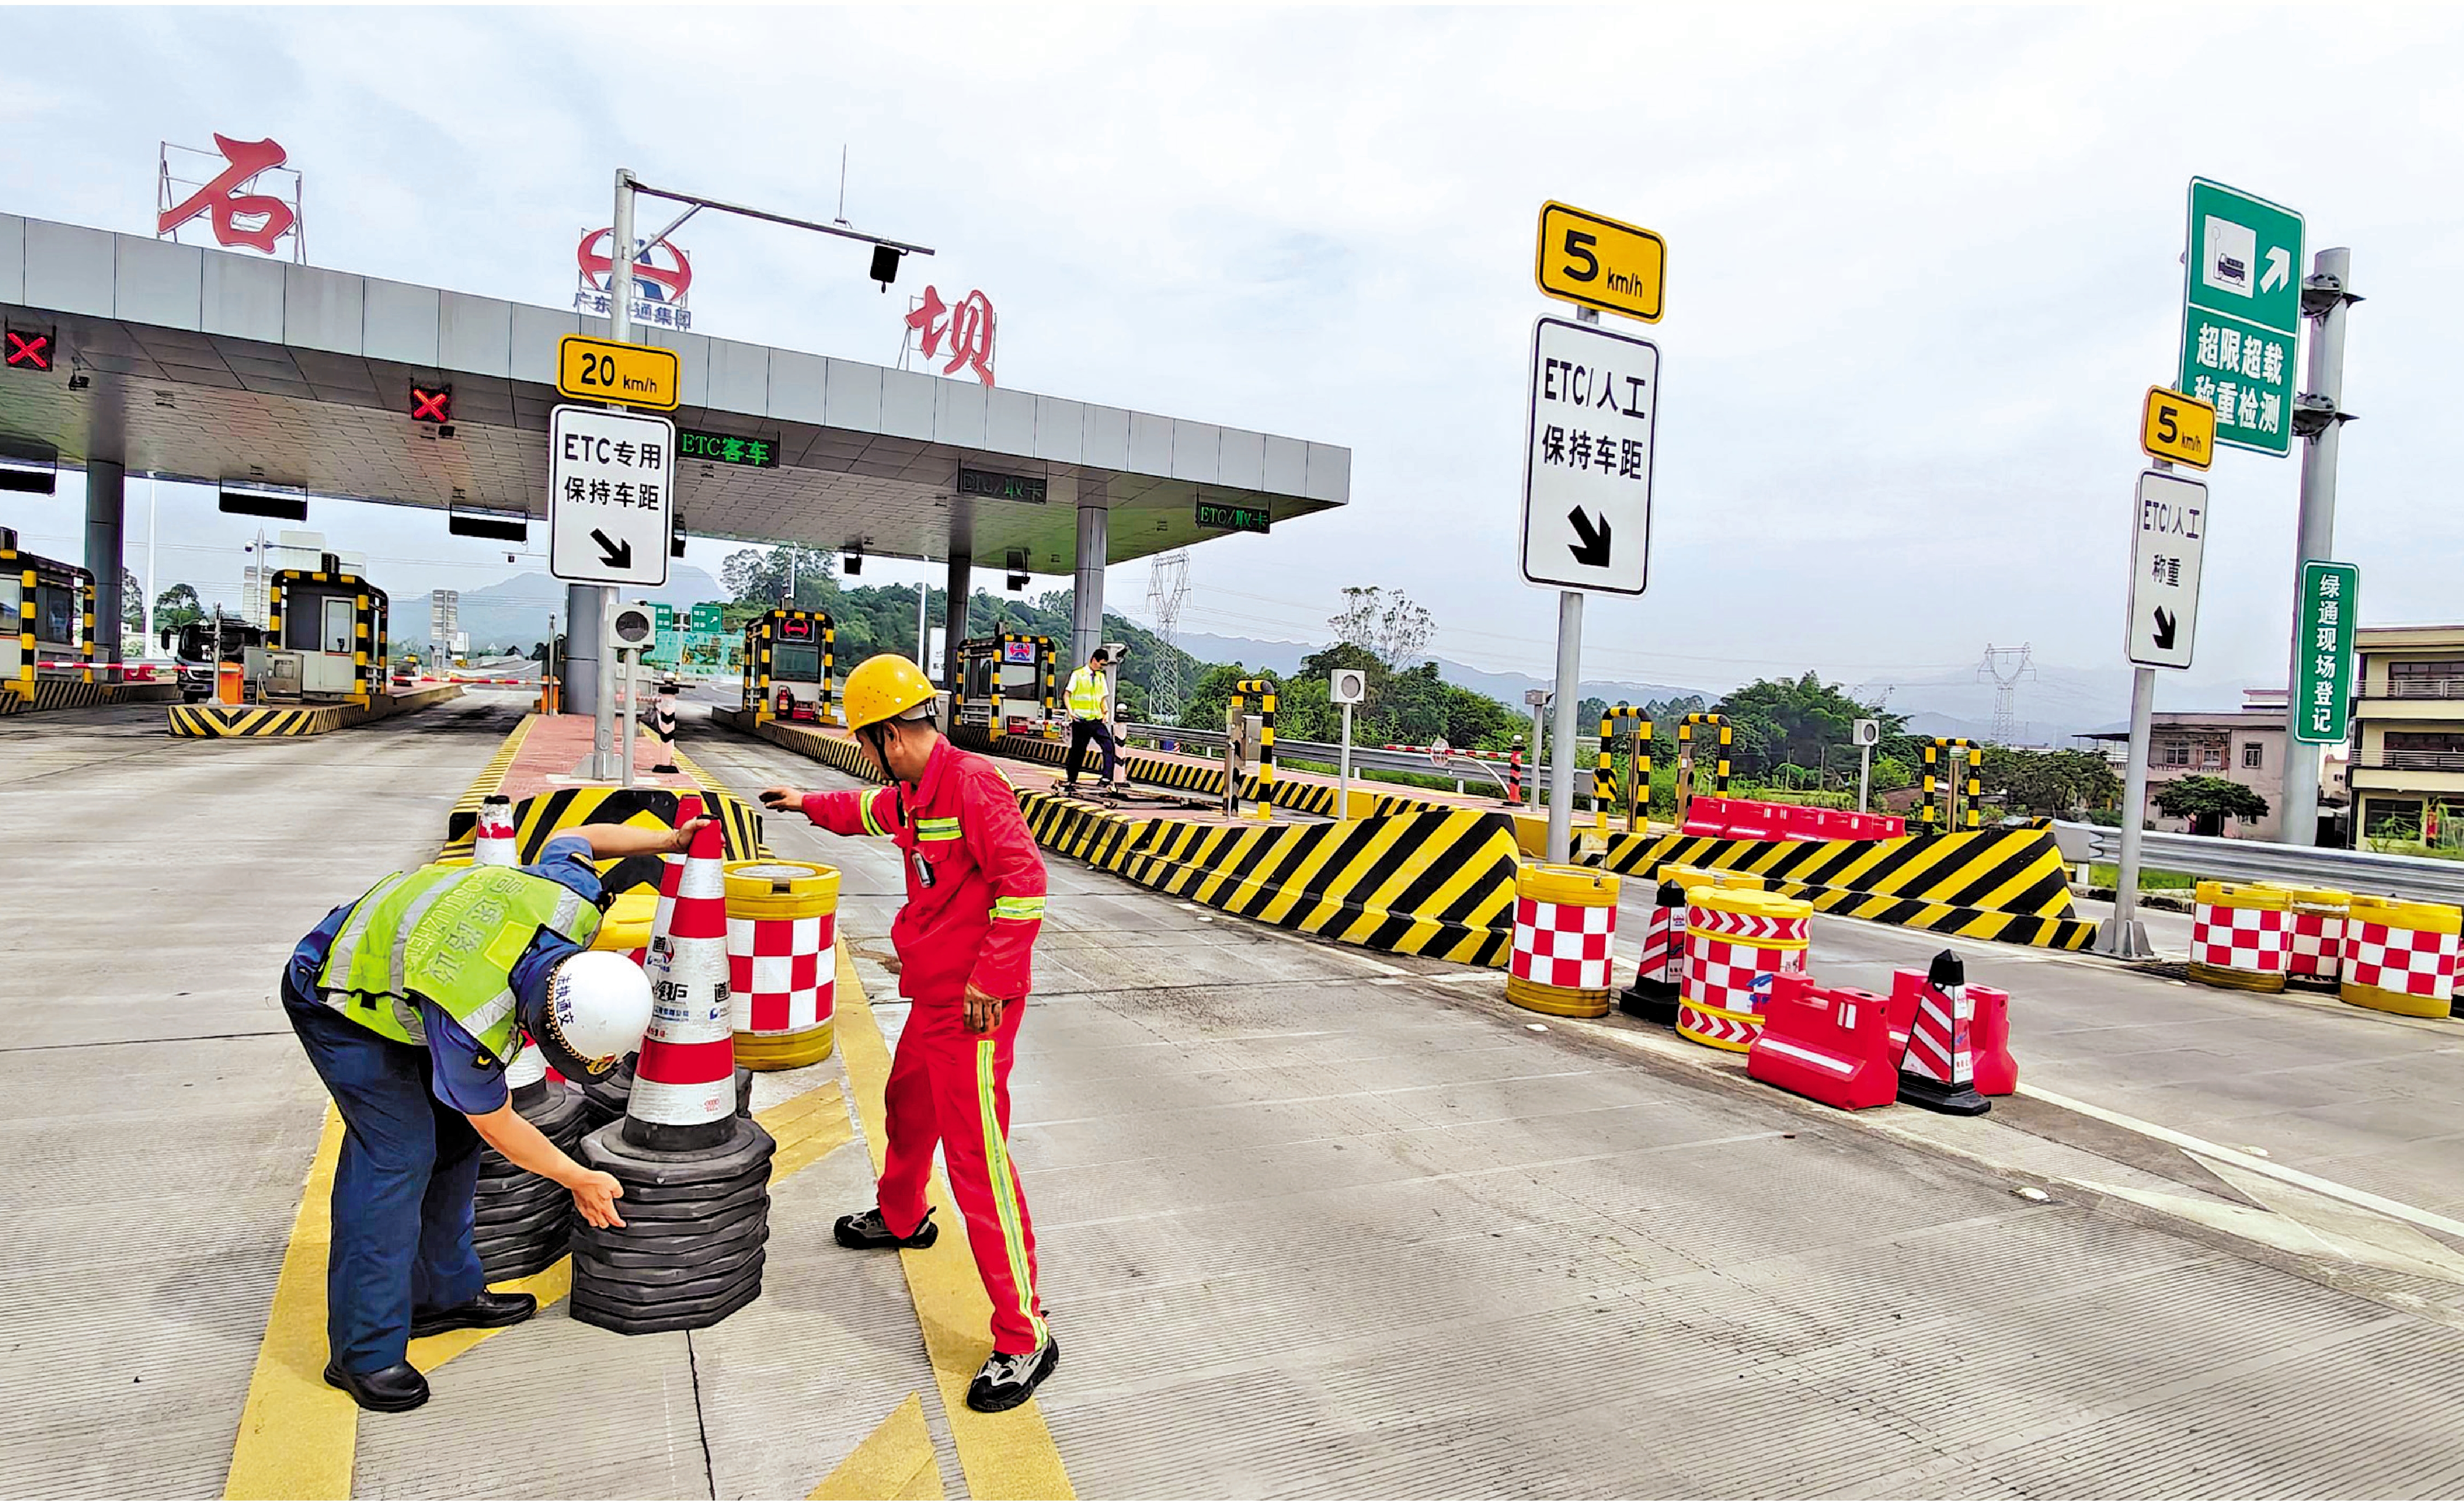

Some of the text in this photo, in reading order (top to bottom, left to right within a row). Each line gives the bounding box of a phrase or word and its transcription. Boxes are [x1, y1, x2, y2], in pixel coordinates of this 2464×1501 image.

[158, 132, 994, 387] 石 坝
[1563, 229, 1643, 299] 5 km/h
[573, 292, 691, 328] 广东通集团
[581, 353, 658, 394] 20 km/h
[2196, 323, 2284, 385] 超限超载
[1544, 357, 1646, 419] ETC/人工
[2158, 405, 2178, 443] 5
[564, 434, 661, 470] ETC专用
[682, 434, 769, 466] ETC客车
[1542, 424, 1643, 480] 保持车距
[564, 476, 659, 511] 保持车距
[2143, 500, 2200, 539] ETC/人工
[2152, 554, 2181, 587] 称重
[2311, 574, 2341, 733] 绿通现场登记
